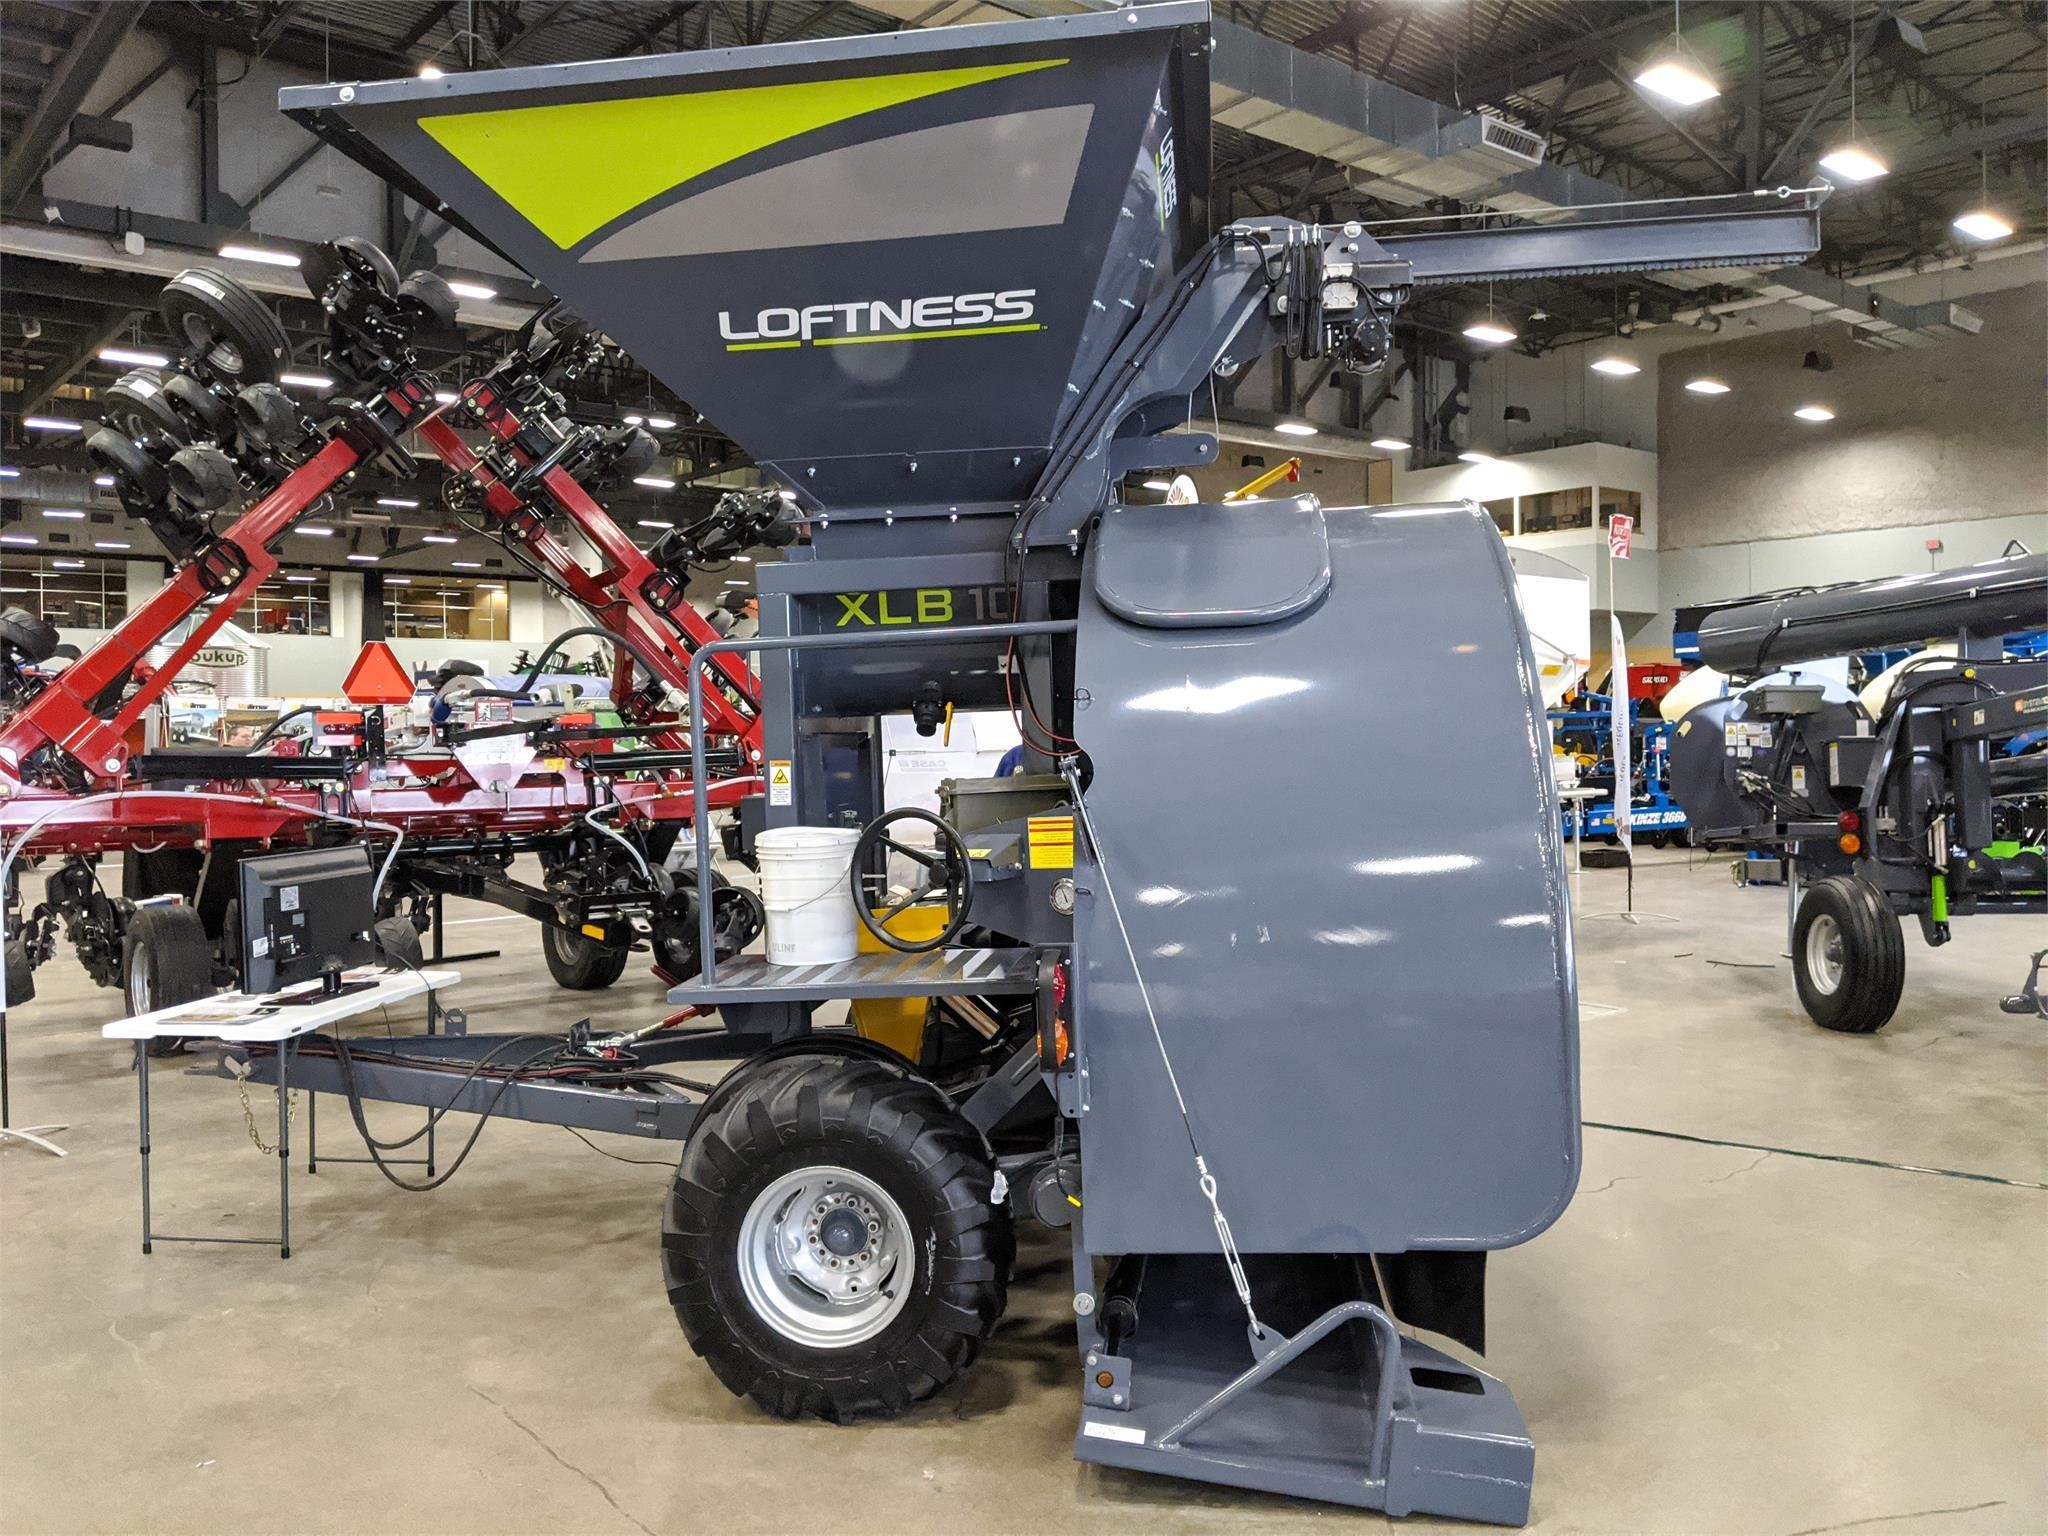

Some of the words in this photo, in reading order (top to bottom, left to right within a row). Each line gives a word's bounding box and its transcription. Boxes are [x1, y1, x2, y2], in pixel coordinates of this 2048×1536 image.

[718, 288, 1037, 340] LOFTNESS
[835, 588, 954, 627] XLB
[1629, 812, 1662, 825] KINZE
